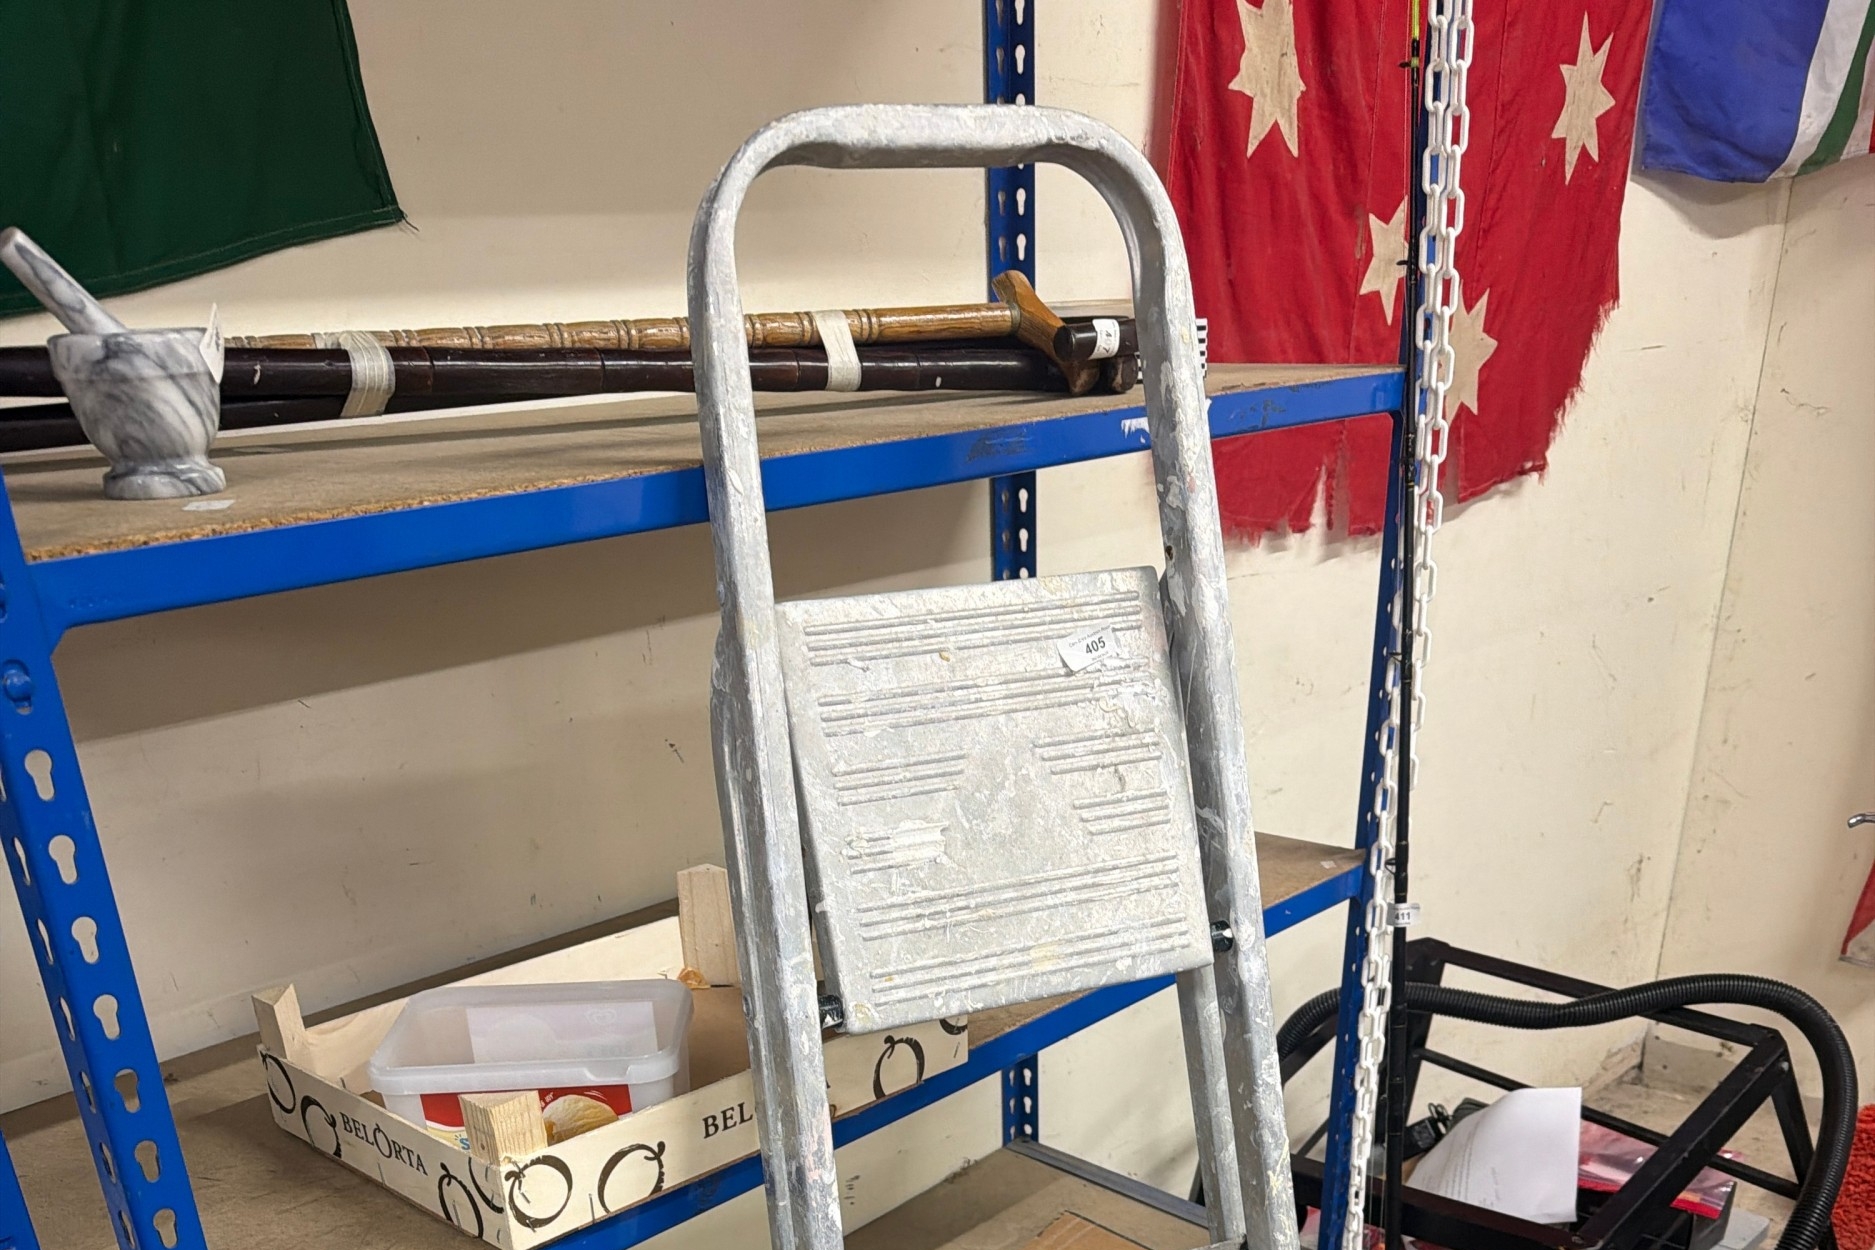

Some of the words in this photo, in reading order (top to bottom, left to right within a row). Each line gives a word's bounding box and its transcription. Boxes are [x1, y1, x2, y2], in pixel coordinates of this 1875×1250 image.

[1085, 635, 1106, 654] 405
[1394, 911, 1411, 921] 411
[339, 1111, 429, 1176] BELORTA
